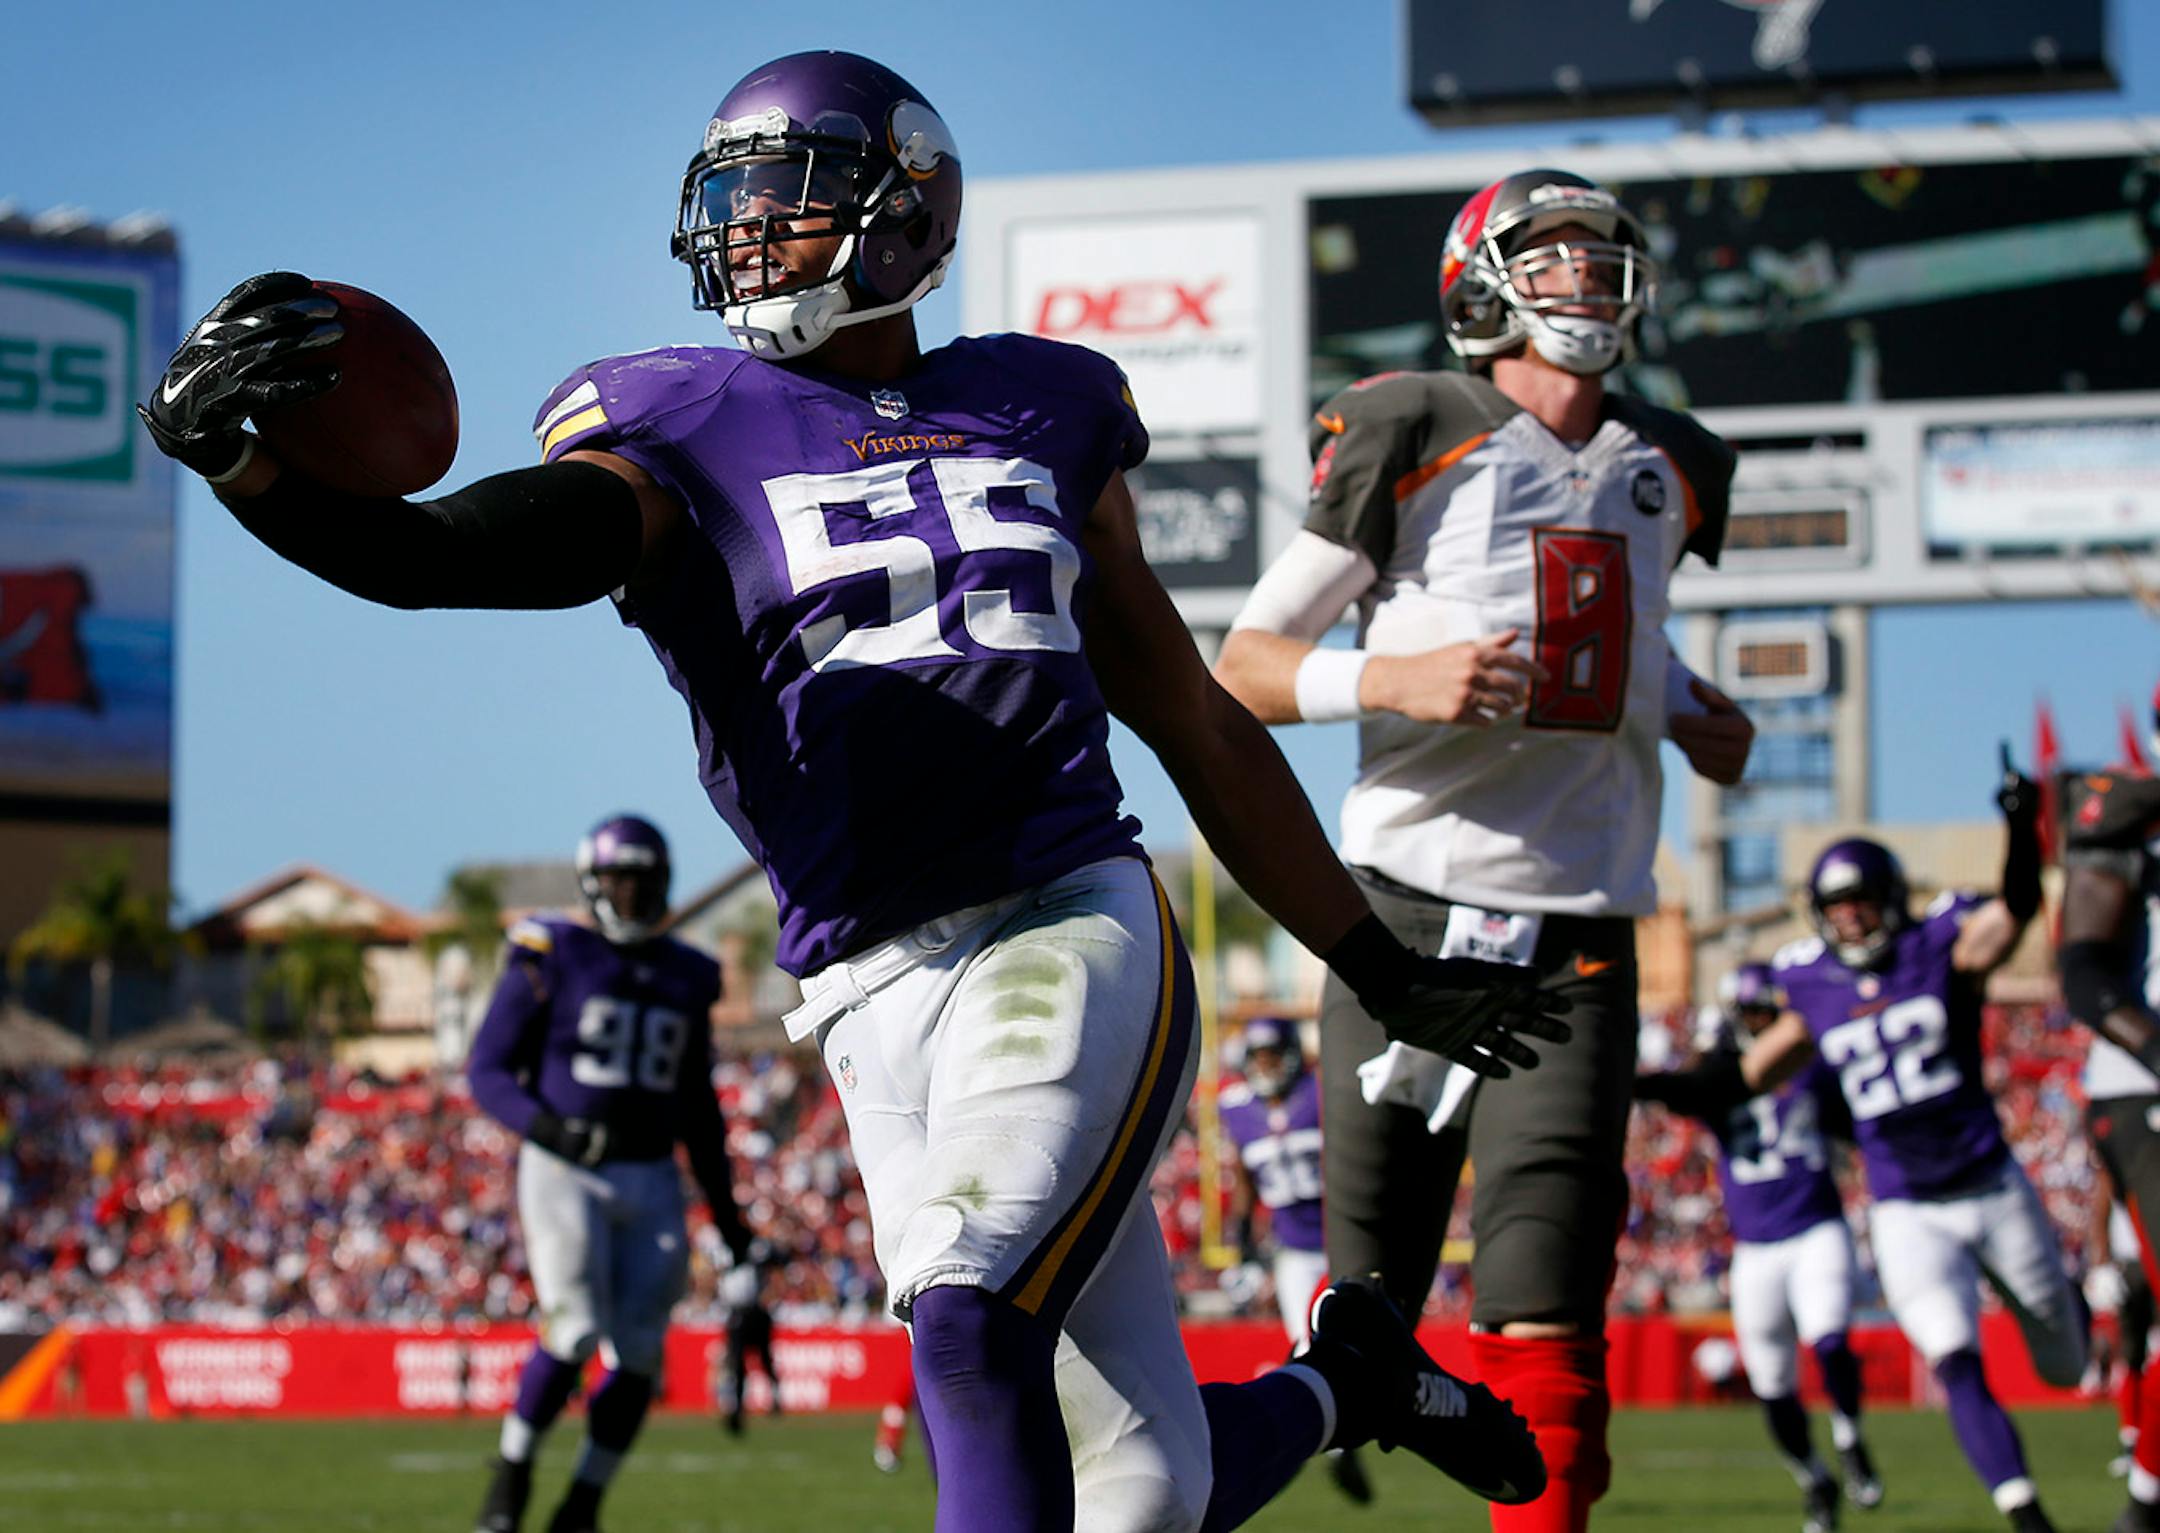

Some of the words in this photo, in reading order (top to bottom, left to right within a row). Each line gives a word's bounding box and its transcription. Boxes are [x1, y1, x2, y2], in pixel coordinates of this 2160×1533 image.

[1035, 275, 1226, 337] DEX
[762, 457, 1081, 673] 55
[1523, 526, 1634, 735] 8
[570, 996, 690, 1092] 98
[1820, 994, 1963, 1121] 22
